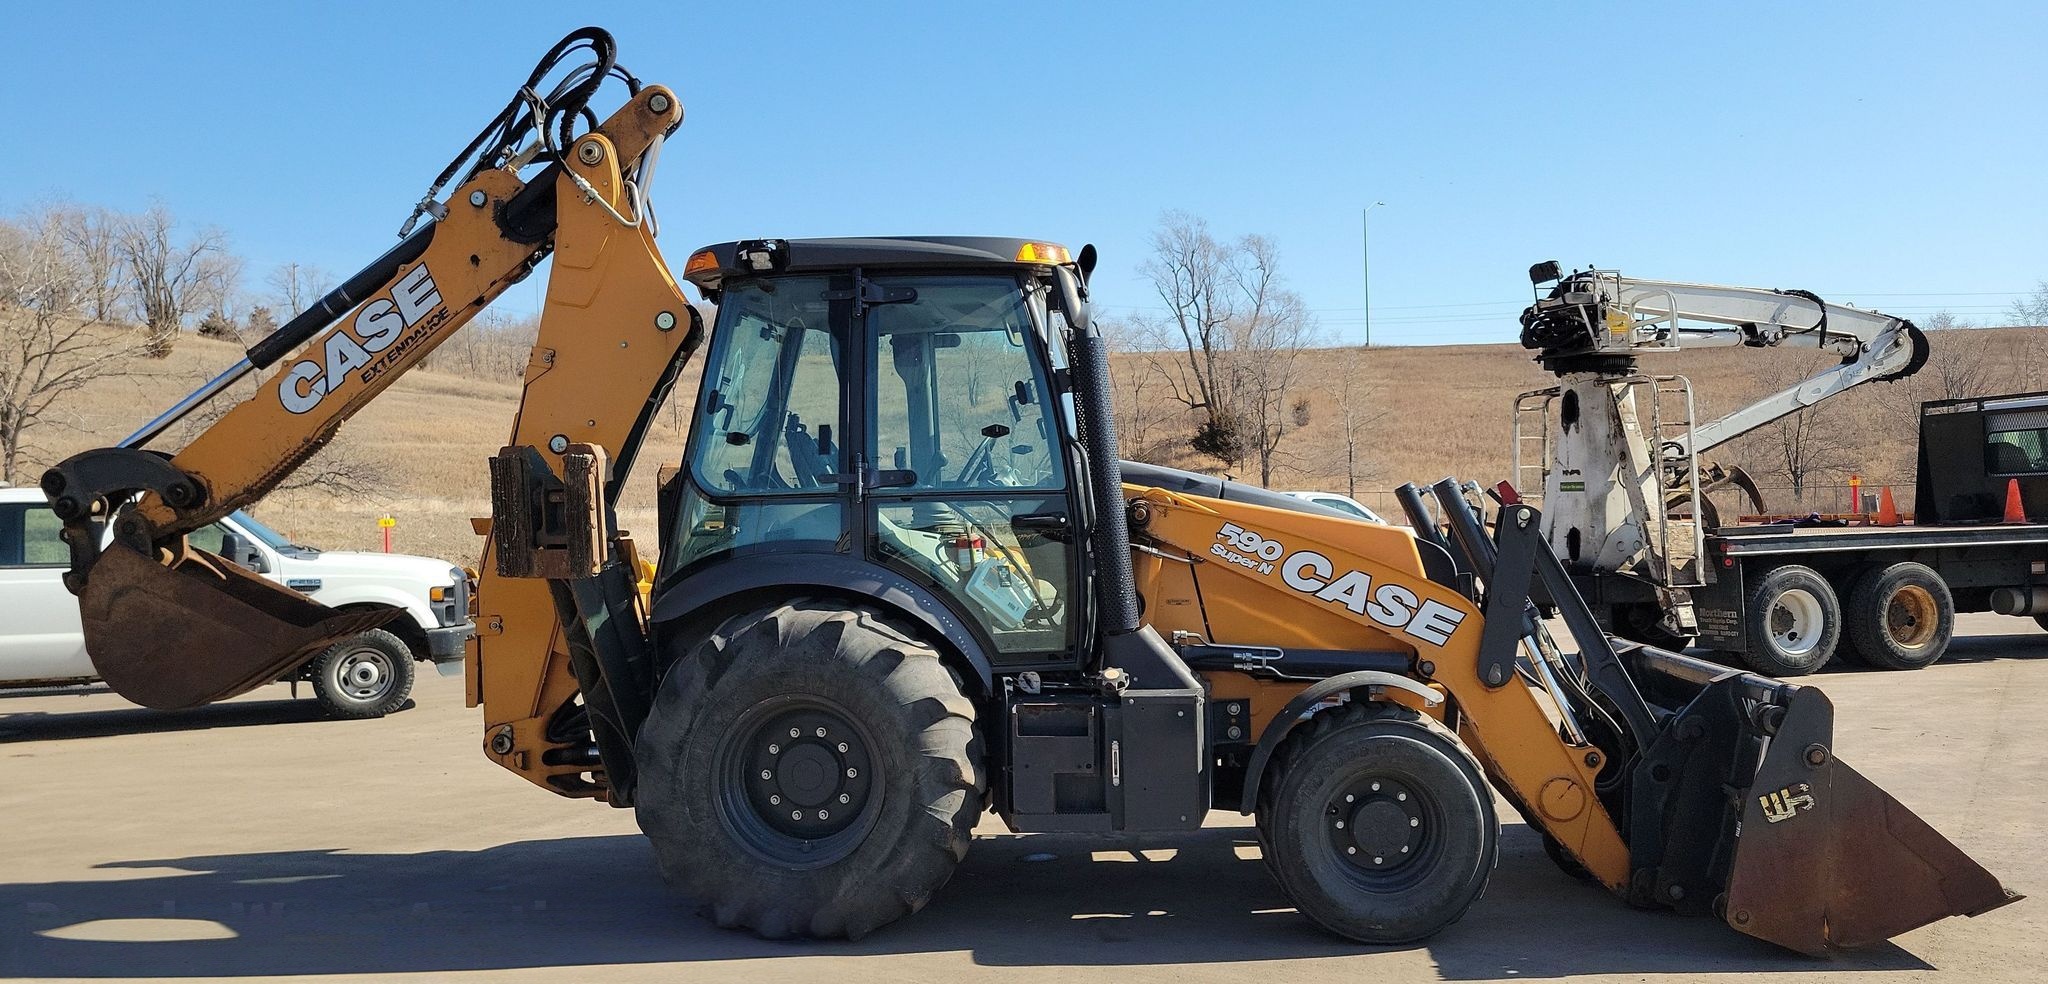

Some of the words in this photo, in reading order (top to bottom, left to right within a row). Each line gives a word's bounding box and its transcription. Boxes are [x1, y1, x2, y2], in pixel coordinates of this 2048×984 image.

[278, 261, 443, 414] CASE
[1210, 543, 1259, 569] Super
[1256, 561, 1275, 576] N
[1216, 522, 1284, 561] 590
[1281, 550, 1467, 647] CASE
[1699, 608, 1738, 618] Northern
